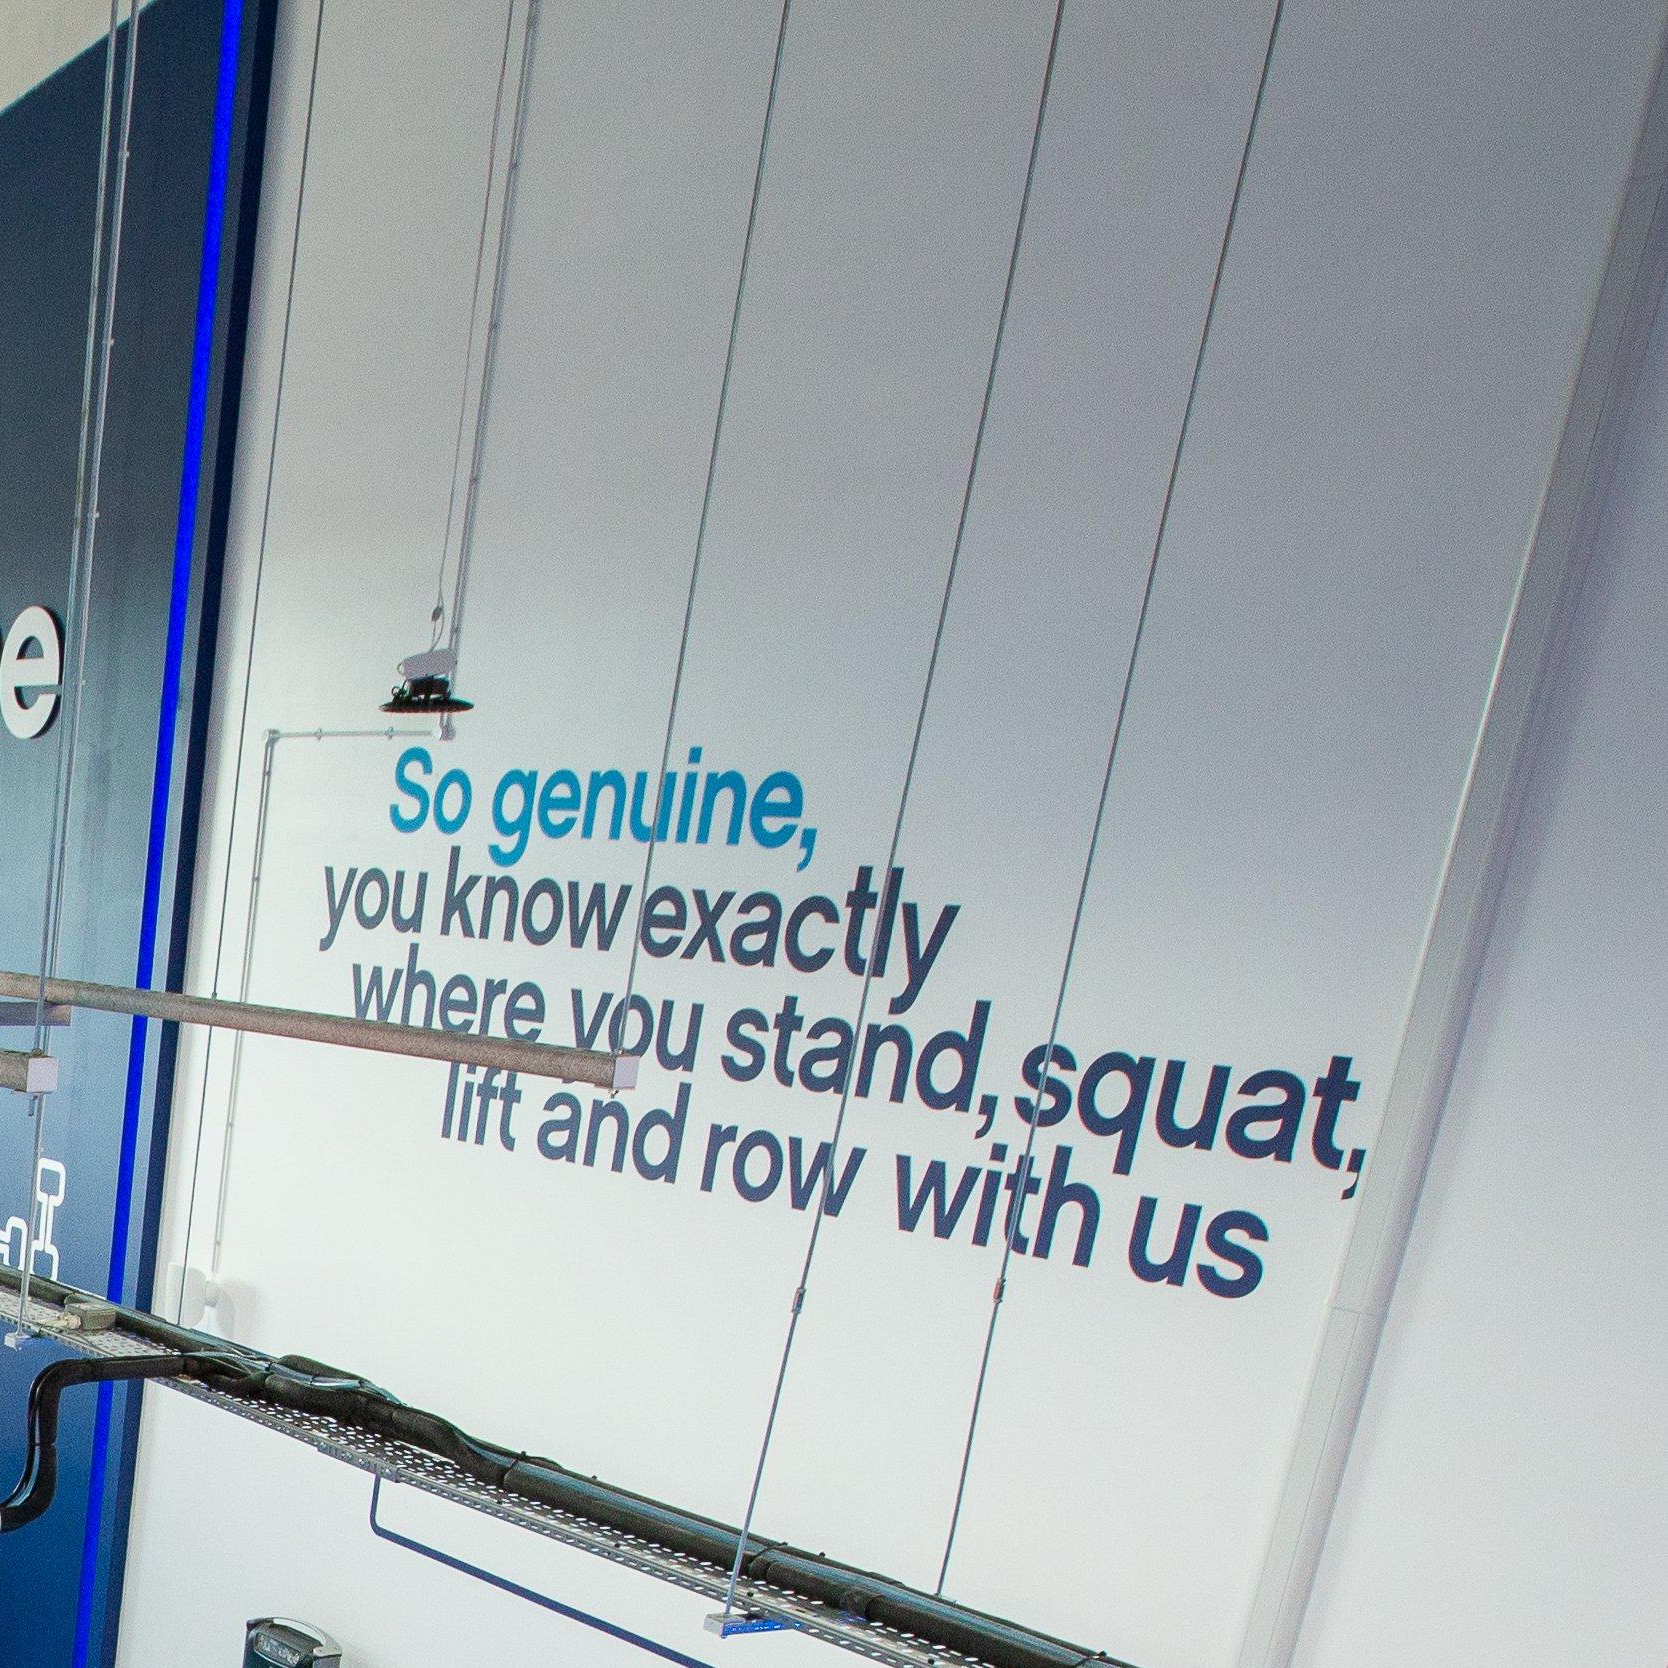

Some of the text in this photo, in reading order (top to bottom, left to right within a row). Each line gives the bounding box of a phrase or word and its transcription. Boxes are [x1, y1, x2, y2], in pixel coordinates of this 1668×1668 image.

[390, 746, 818, 872] So genuine,
[319, 846, 960, 1015] you know exactly
[351, 943, 1366, 1200] where you stand, squat,
[440, 1061, 1269, 1299] lift and row with us
